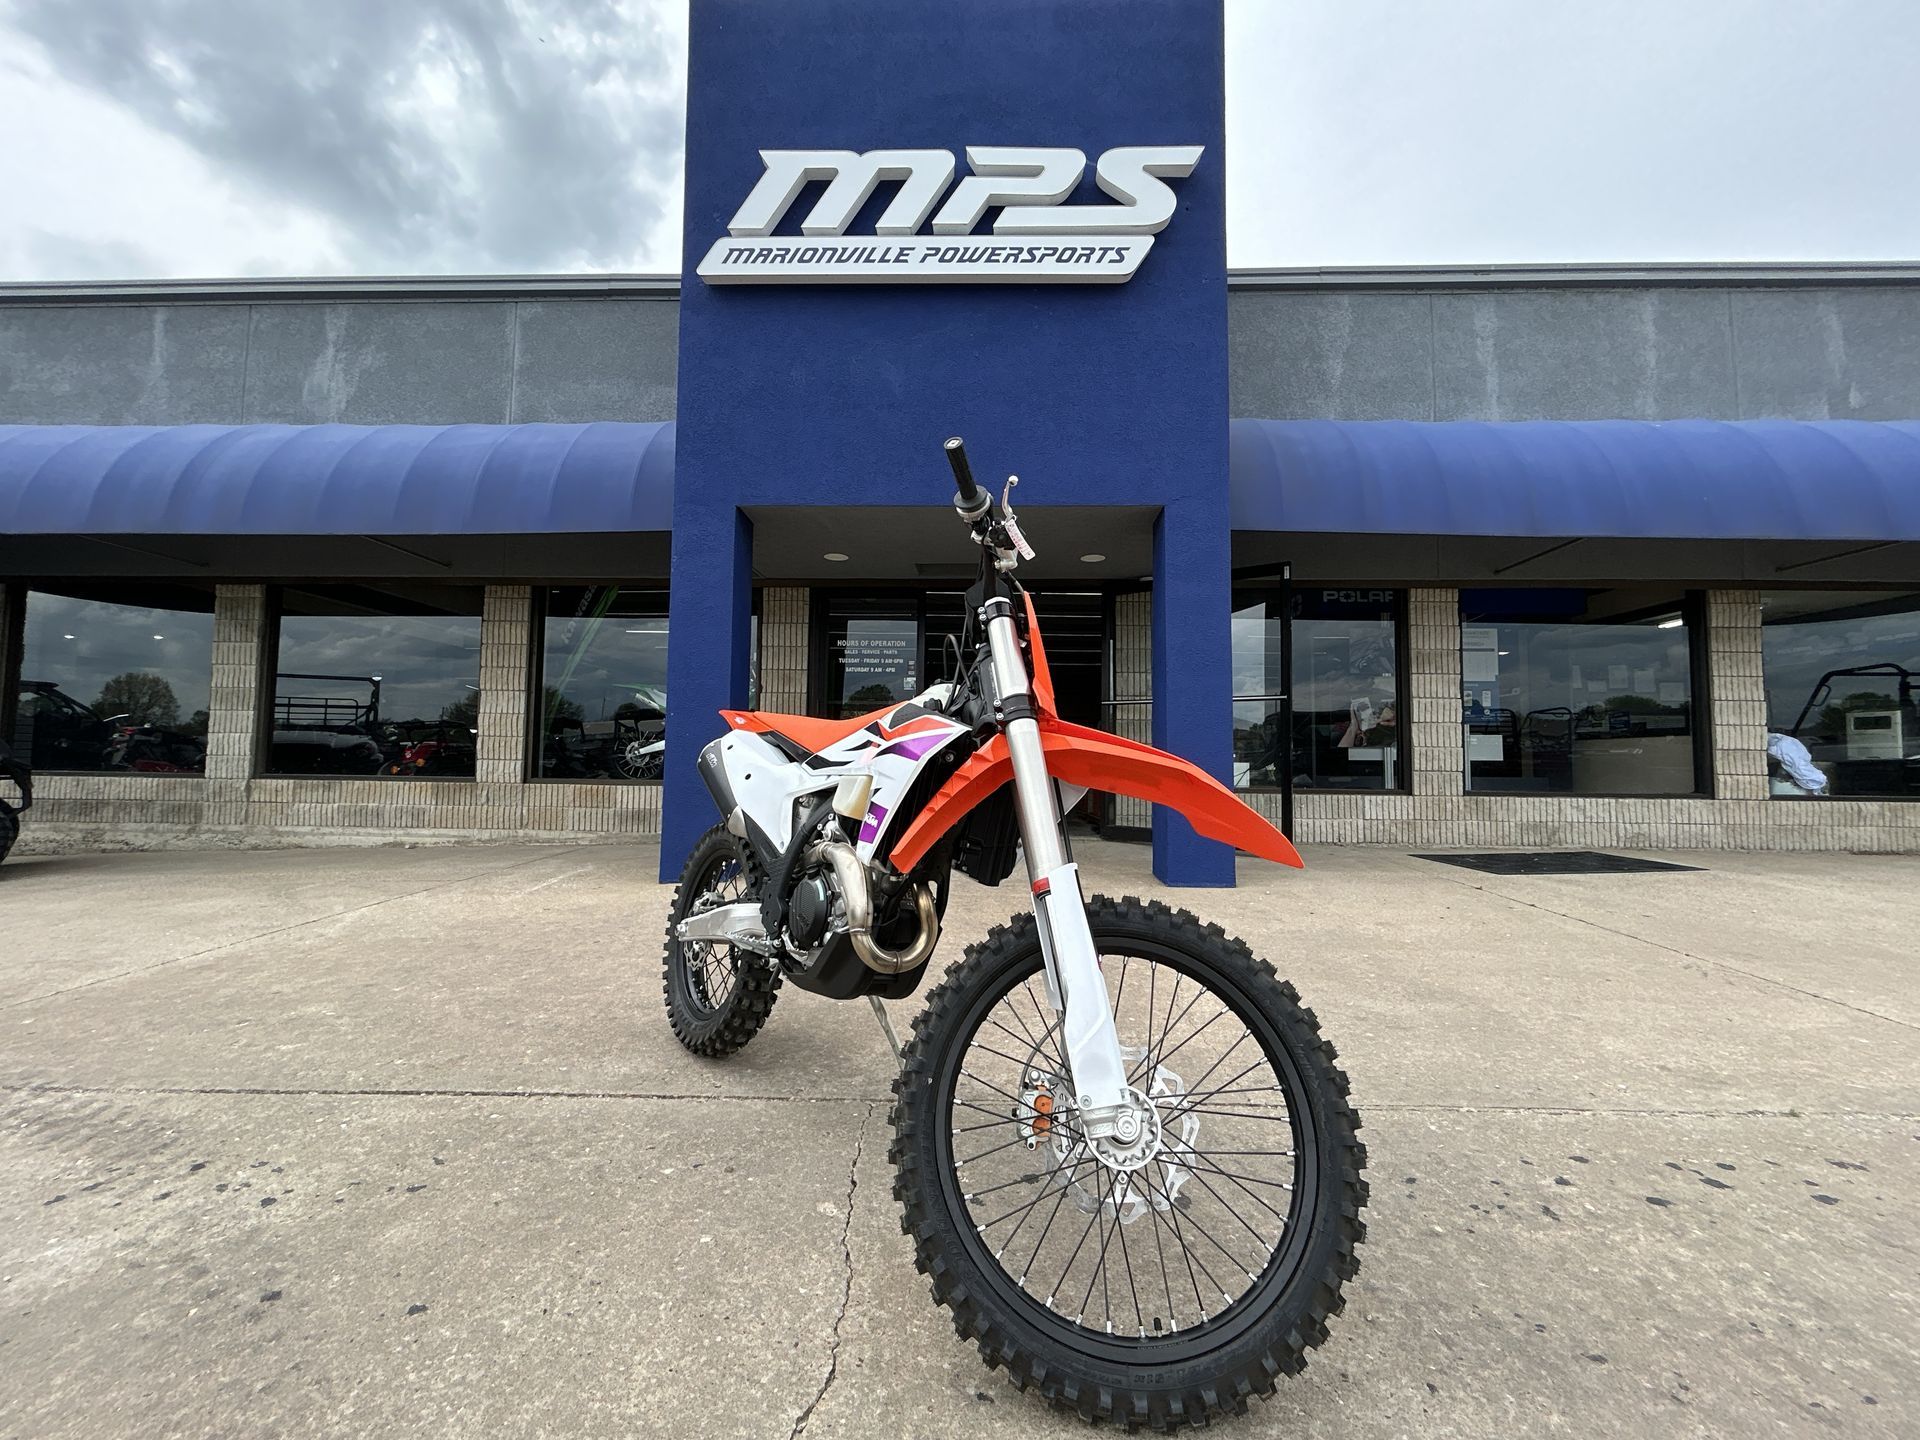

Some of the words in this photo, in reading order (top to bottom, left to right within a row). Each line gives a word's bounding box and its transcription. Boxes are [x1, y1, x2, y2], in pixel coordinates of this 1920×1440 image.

[727, 145, 1206, 236] MPS
[721, 247, 916, 264] MARIONVILLE
[919, 246, 1131, 264] POWERSPORTS
